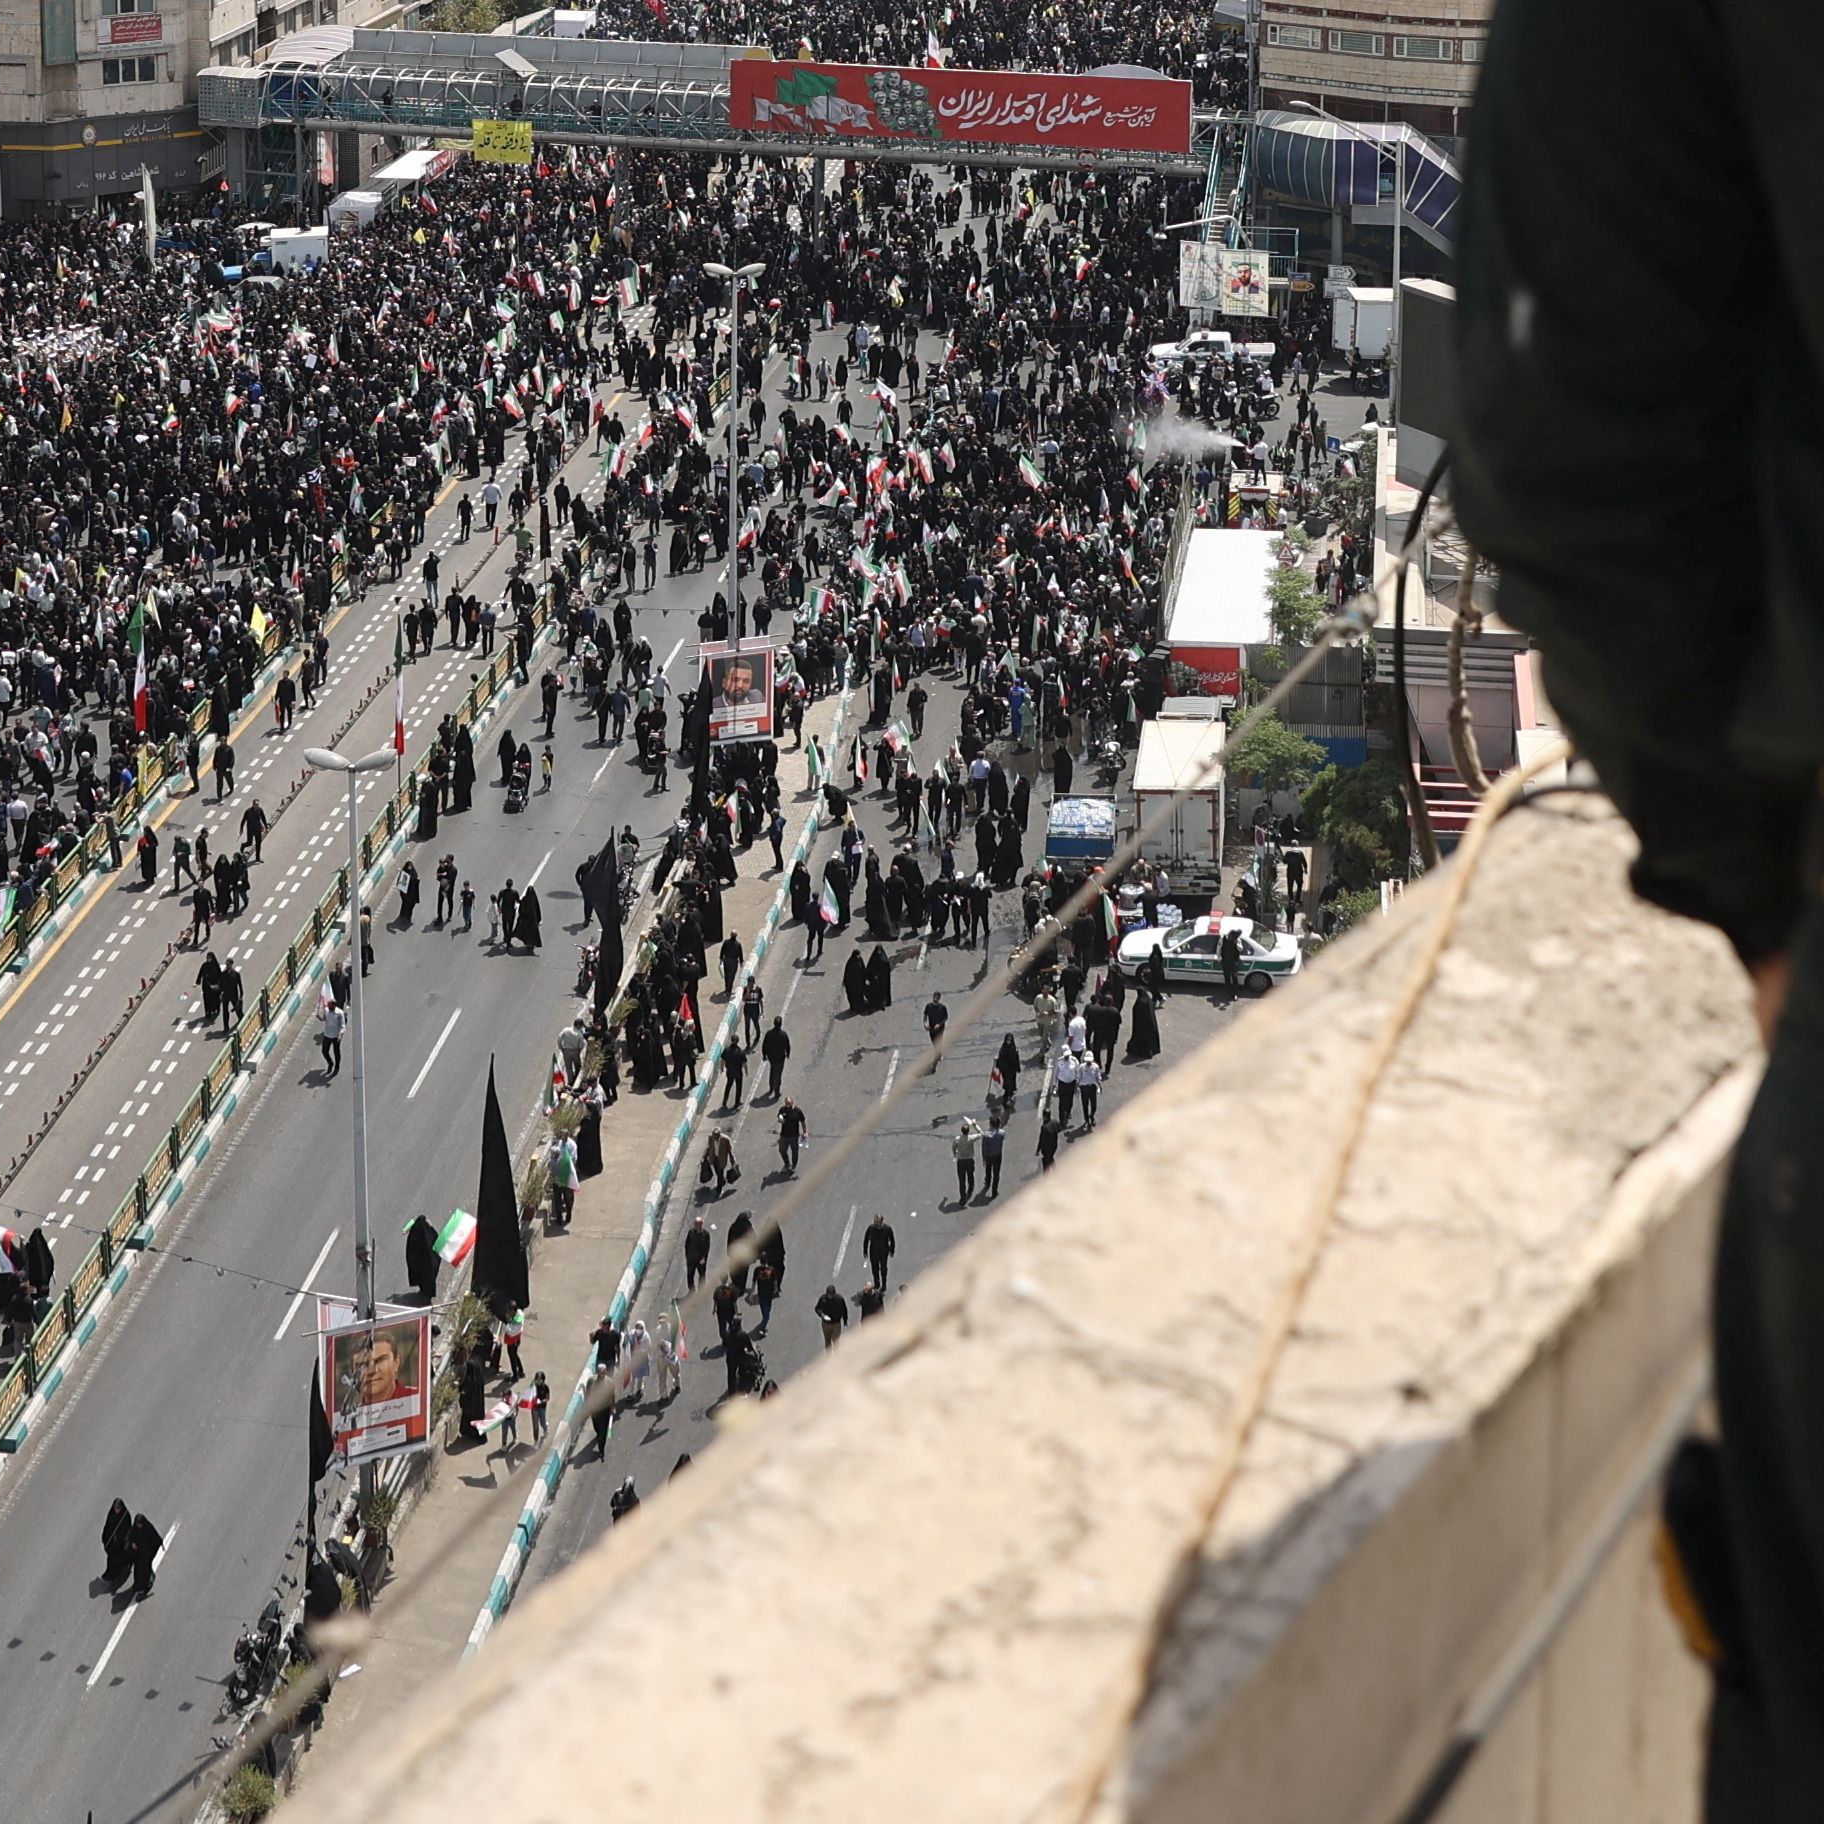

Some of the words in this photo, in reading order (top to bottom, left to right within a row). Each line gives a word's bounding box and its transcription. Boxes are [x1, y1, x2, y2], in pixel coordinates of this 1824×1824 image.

[939, 89, 994, 129] ایران
[987, 93, 1047, 126] اقتدار
[1036, 92, 1102, 133] شهدای
[1128, 106, 1157, 127] آیین
[124, 124, 139, 136] ایران
[138, 119, 147, 136] ملی
[146, 115, 174, 133] بانک
